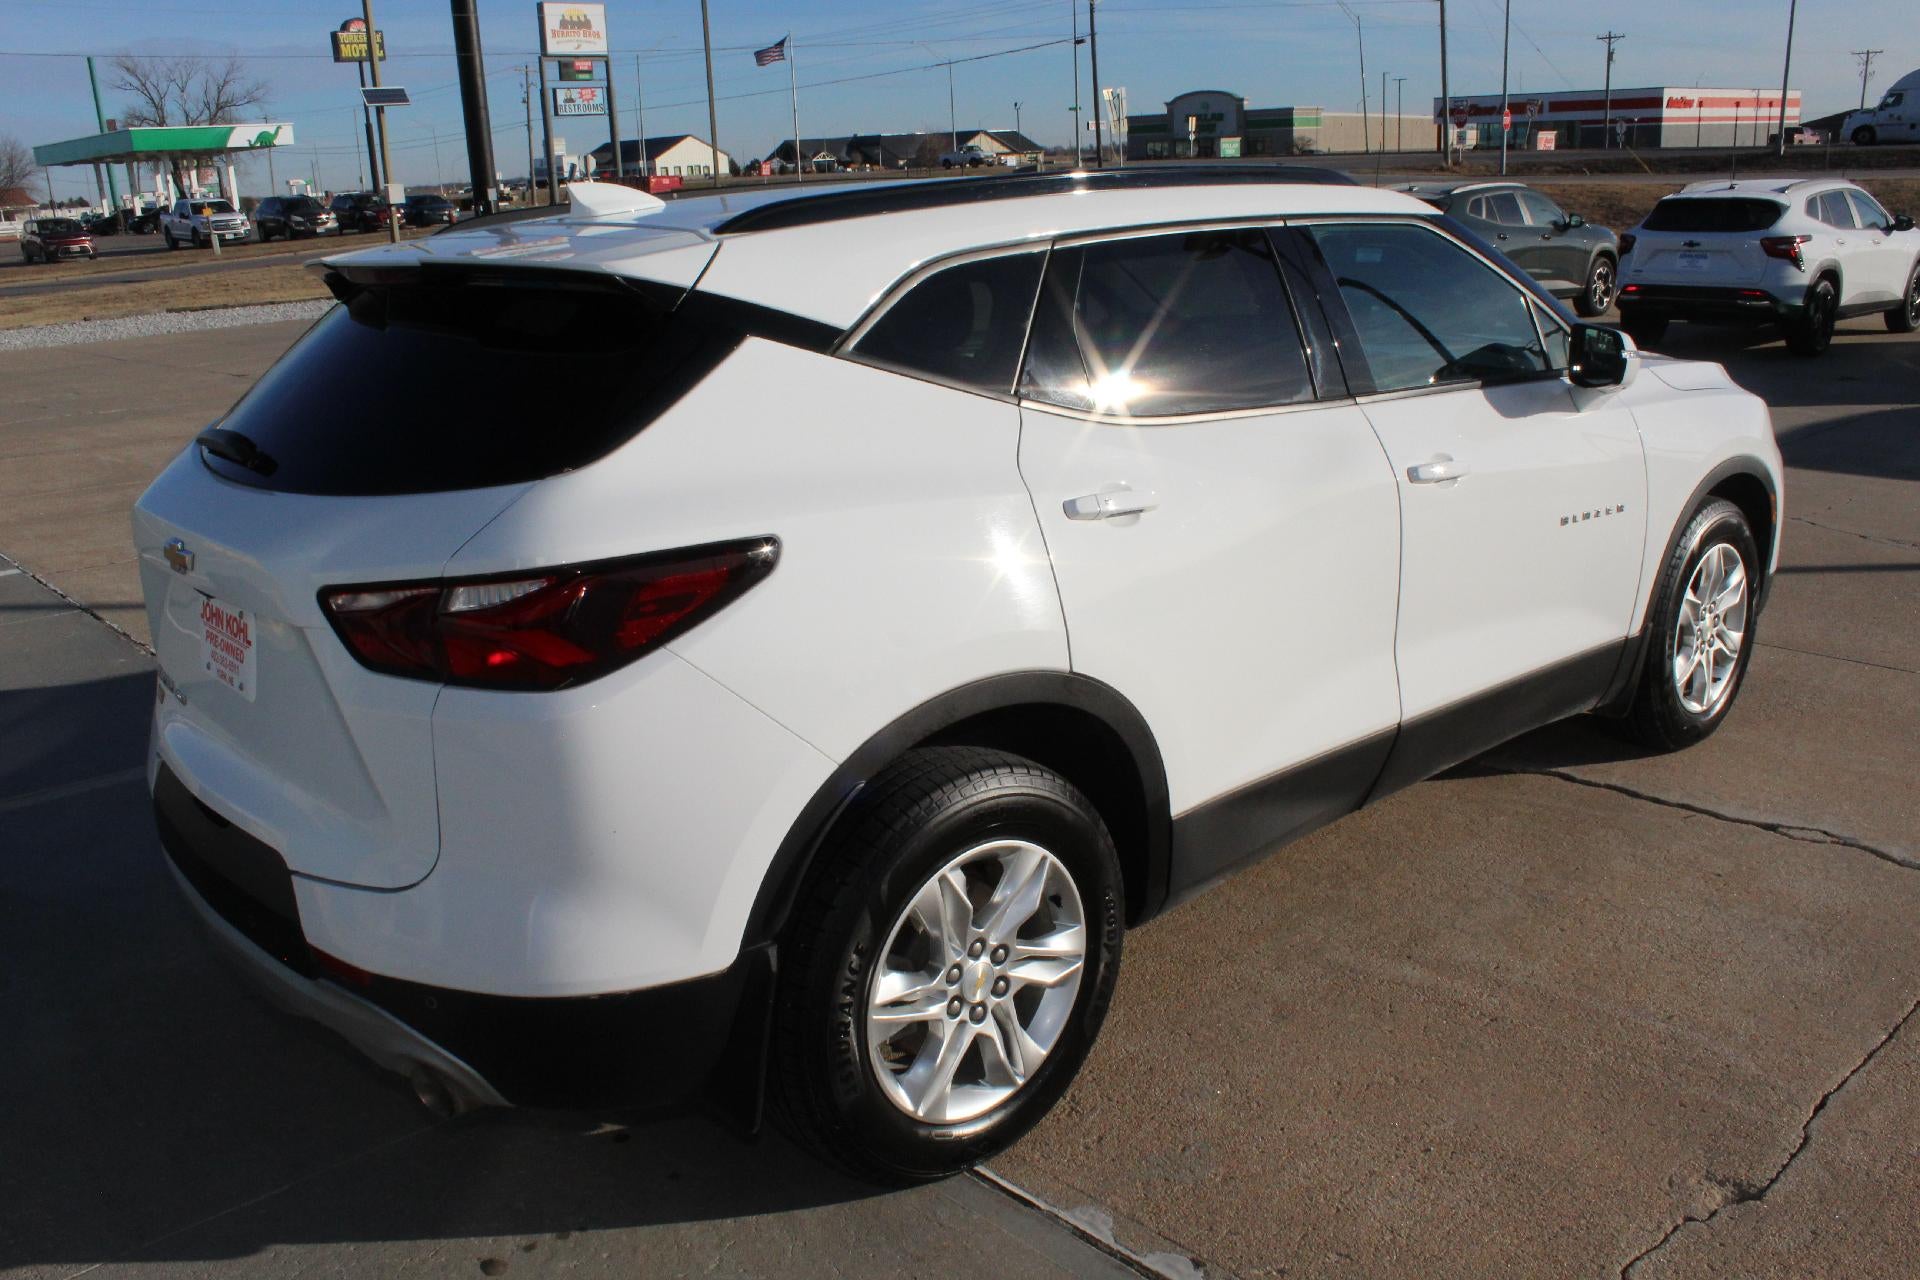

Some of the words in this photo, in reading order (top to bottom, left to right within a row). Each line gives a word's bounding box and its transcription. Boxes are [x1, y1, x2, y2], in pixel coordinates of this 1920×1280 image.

[340, 43, 385, 57] MOTL
[559, 103, 605, 113] RESTROOMS
[1560, 503, 1625, 526] BLAZER
[201, 600, 225, 631] JOHN
[225, 611, 252, 647] KOHL
